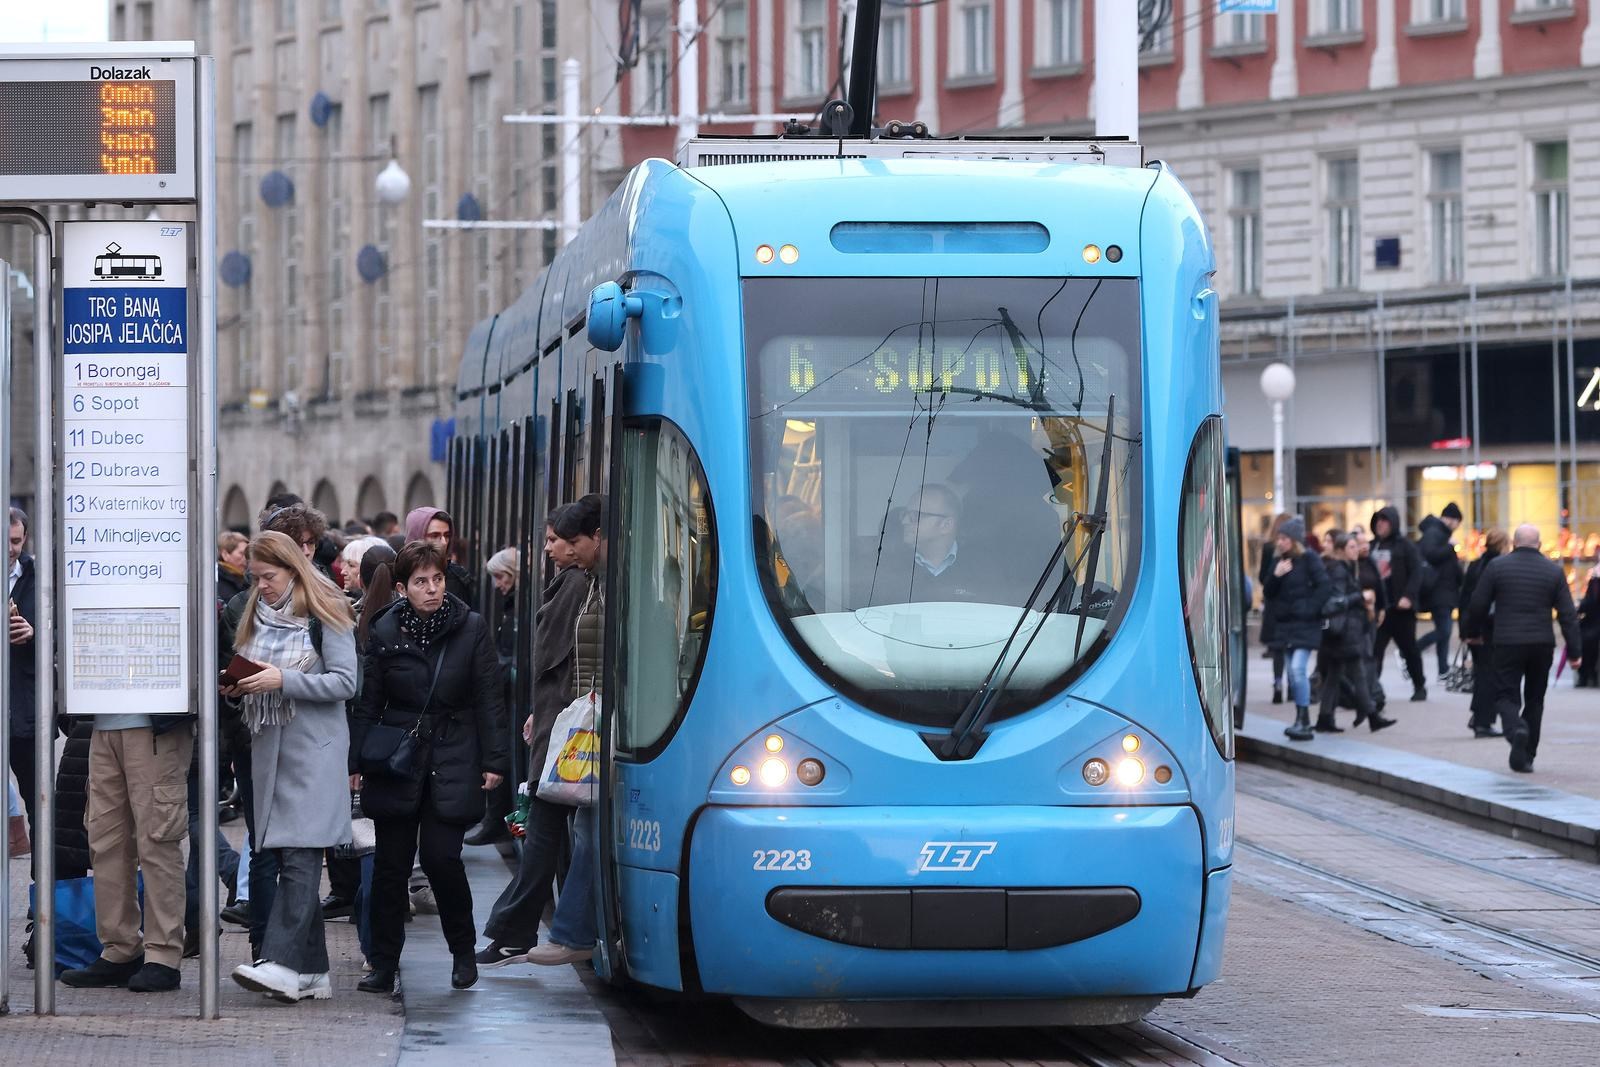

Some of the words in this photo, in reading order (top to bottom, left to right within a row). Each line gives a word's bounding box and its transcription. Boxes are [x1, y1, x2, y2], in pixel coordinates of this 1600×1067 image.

[90, 66, 151, 80] Dolazak
[102, 84, 153, 102] 0min
[102, 107, 153, 125] 3min
[102, 131, 153, 149] 4min
[102, 155, 153, 173] 4min
[88, 297, 117, 317] TRG
[124, 297, 161, 317] BANA
[66, 323, 113, 344] JOSIPA
[118, 319, 183, 344] JELAČIĆA
[74, 362, 82, 381] 1
[88, 362, 160, 381] Borongaj
[789, 344, 815, 392] 6
[874, 347, 1035, 394] SOPOT
[73, 394, 85, 413] 6
[91, 395, 140, 413] Sopot
[69, 428, 84, 447] 11
[91, 430, 144, 445] Dubec
[66, 461, 86, 480] 12
[91, 462, 160, 477] Dubrava
[66, 494, 86, 513] 13
[89, 496, 165, 511] Kvaternikov
[170, 497, 186, 514] trg
[68, 526, 86, 545] 14
[94, 528, 182, 546] Mihaljevac
[67, 560, 86, 578] 17
[90, 561, 162, 579] Borongaj
[630, 818, 661, 852] 2223
[752, 849, 812, 871] 2223
[920, 841, 998, 871] ZET
